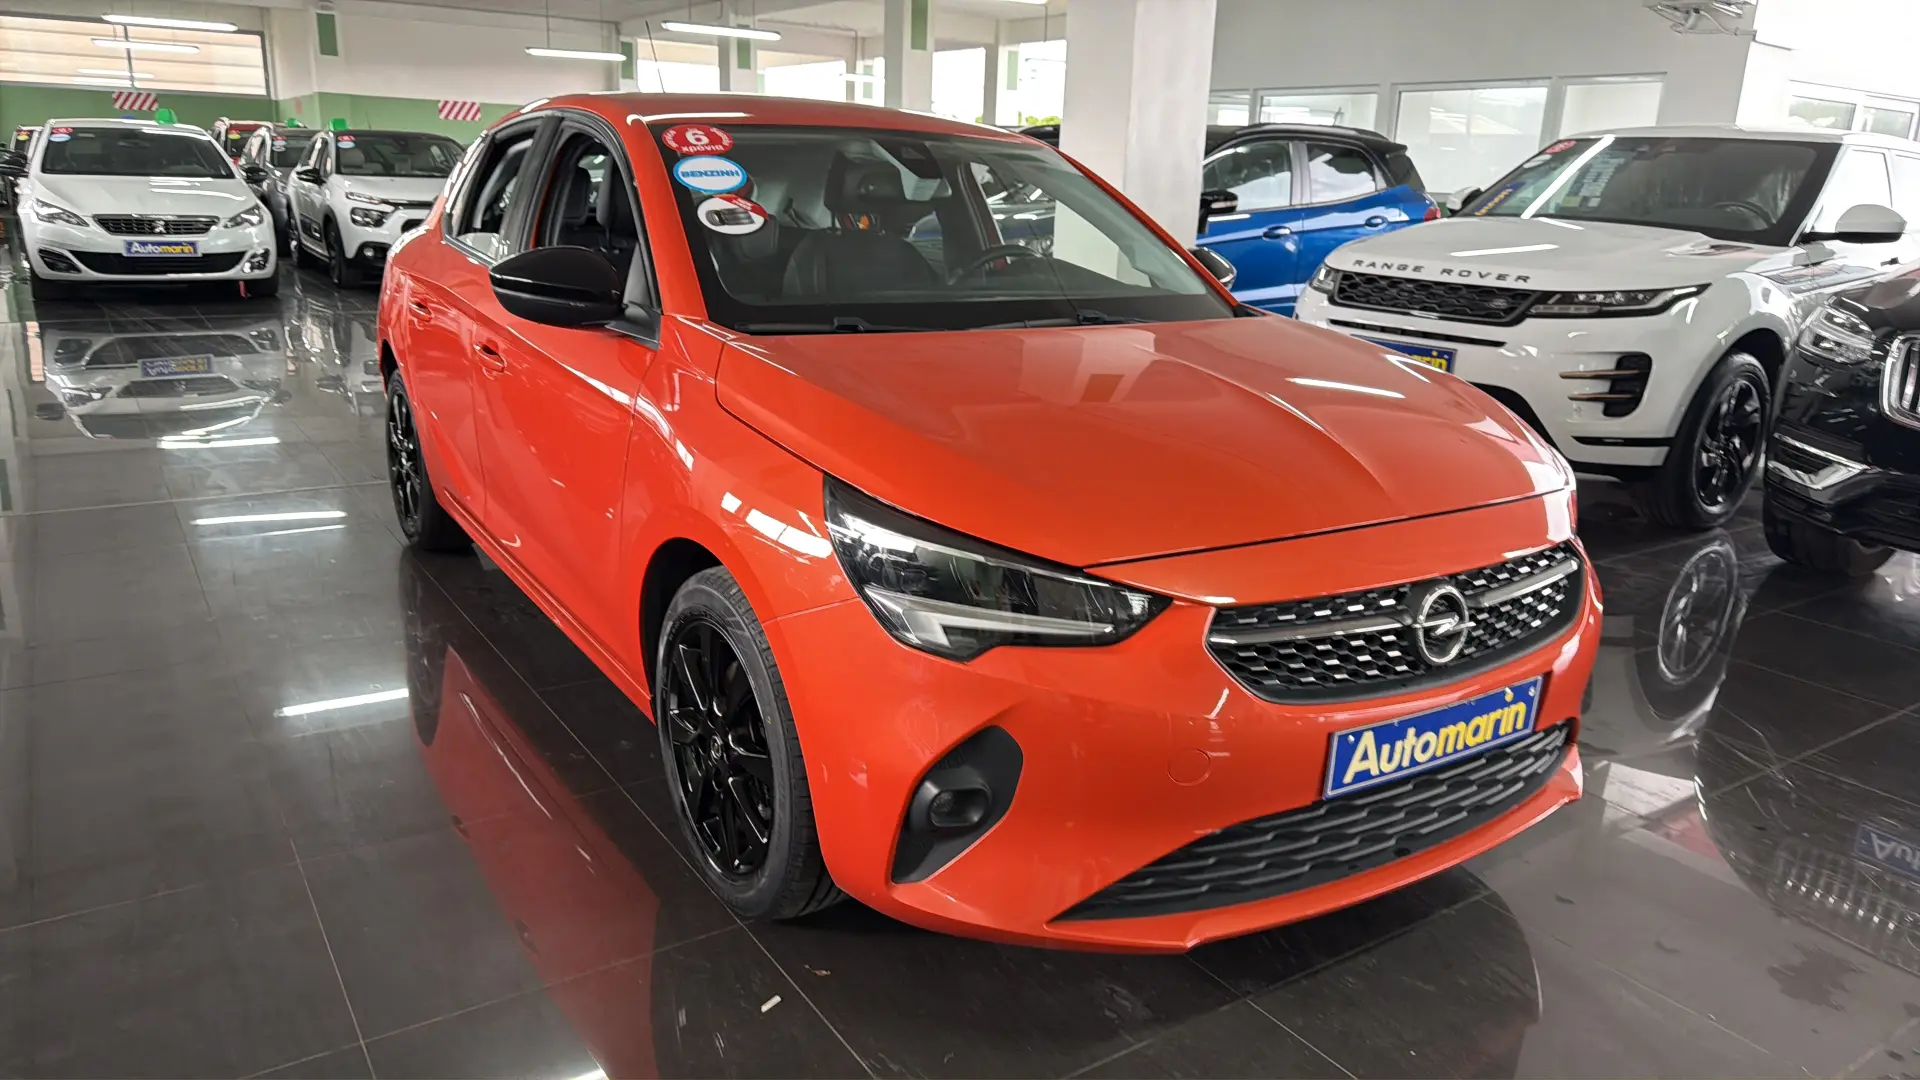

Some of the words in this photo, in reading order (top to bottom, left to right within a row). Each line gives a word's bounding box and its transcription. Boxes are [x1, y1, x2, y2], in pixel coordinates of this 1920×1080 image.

[685, 128, 709, 145] 6
[130, 241, 194, 254] Automarin
[1352, 259, 1425, 273] RANGE
[1440, 268, 1532, 283] ROVER
[1342, 691, 1527, 784] Automarin
